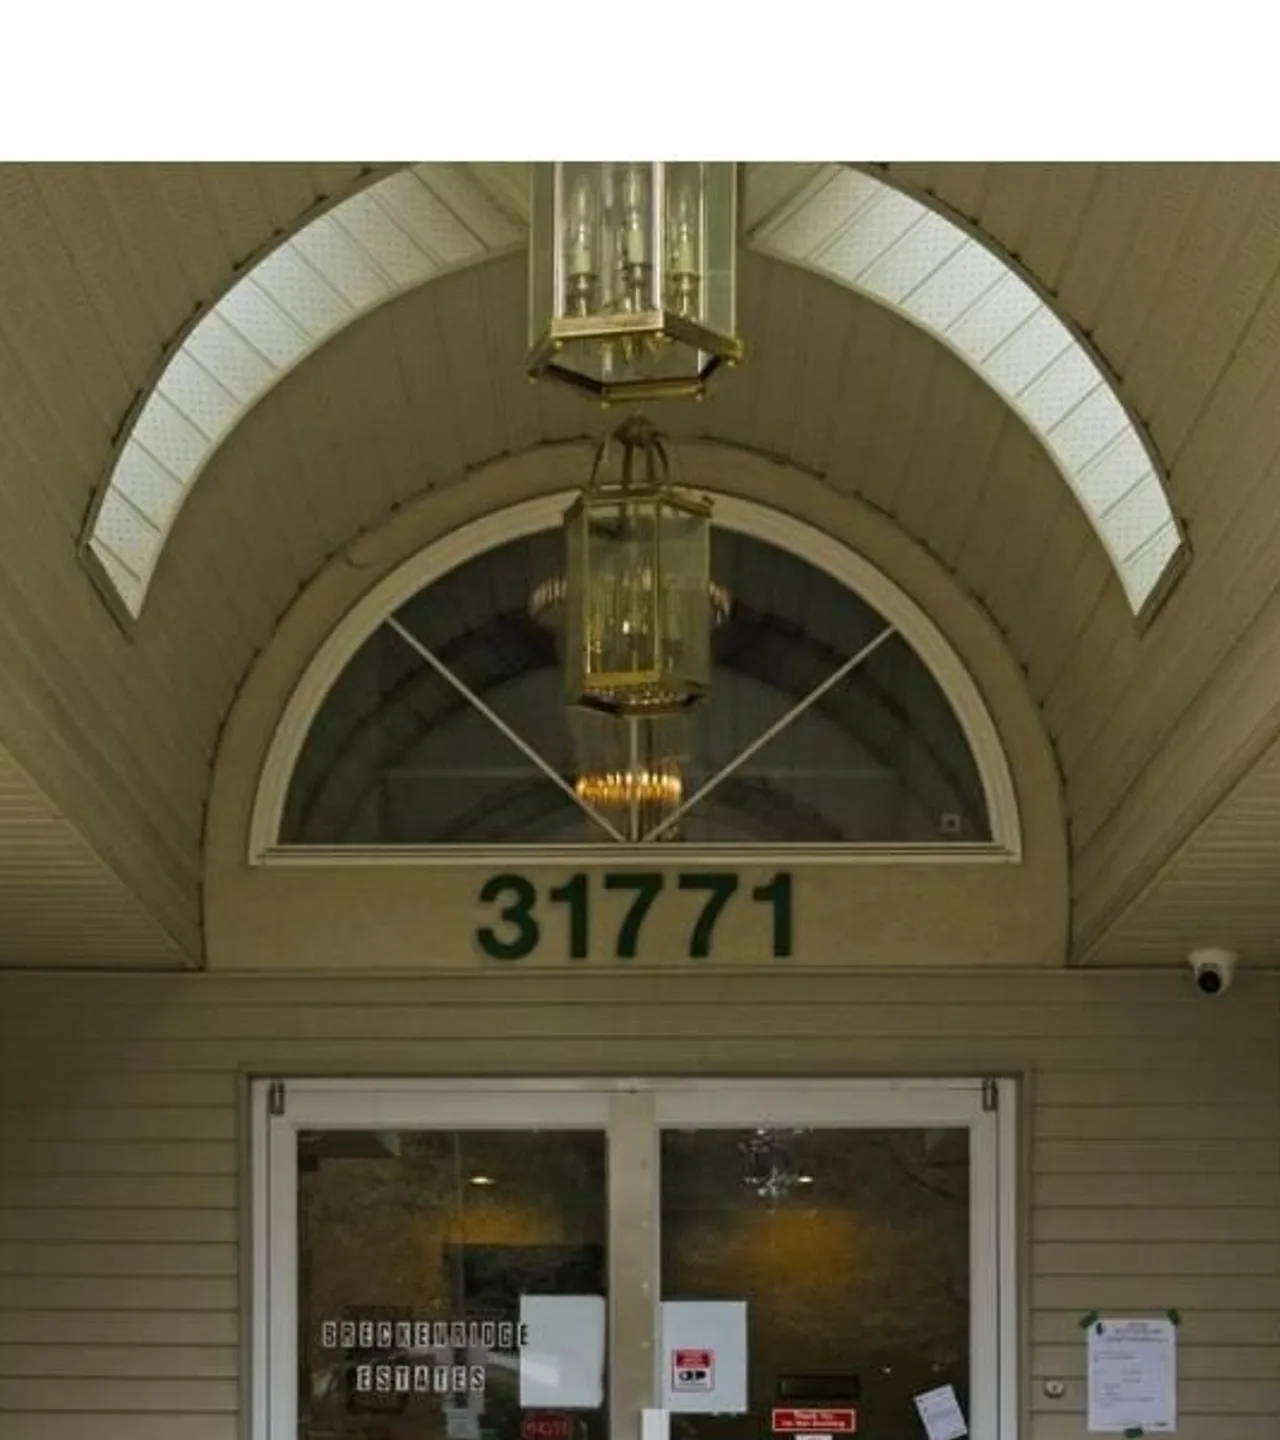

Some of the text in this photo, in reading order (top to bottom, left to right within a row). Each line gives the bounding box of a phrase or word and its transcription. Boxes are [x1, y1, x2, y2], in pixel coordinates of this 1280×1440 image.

[476, 872, 793, 960] 31771
[322, 1321, 529, 1348] BRECKENRIDGE
[356, 1365, 486, 1392] ESTATES
